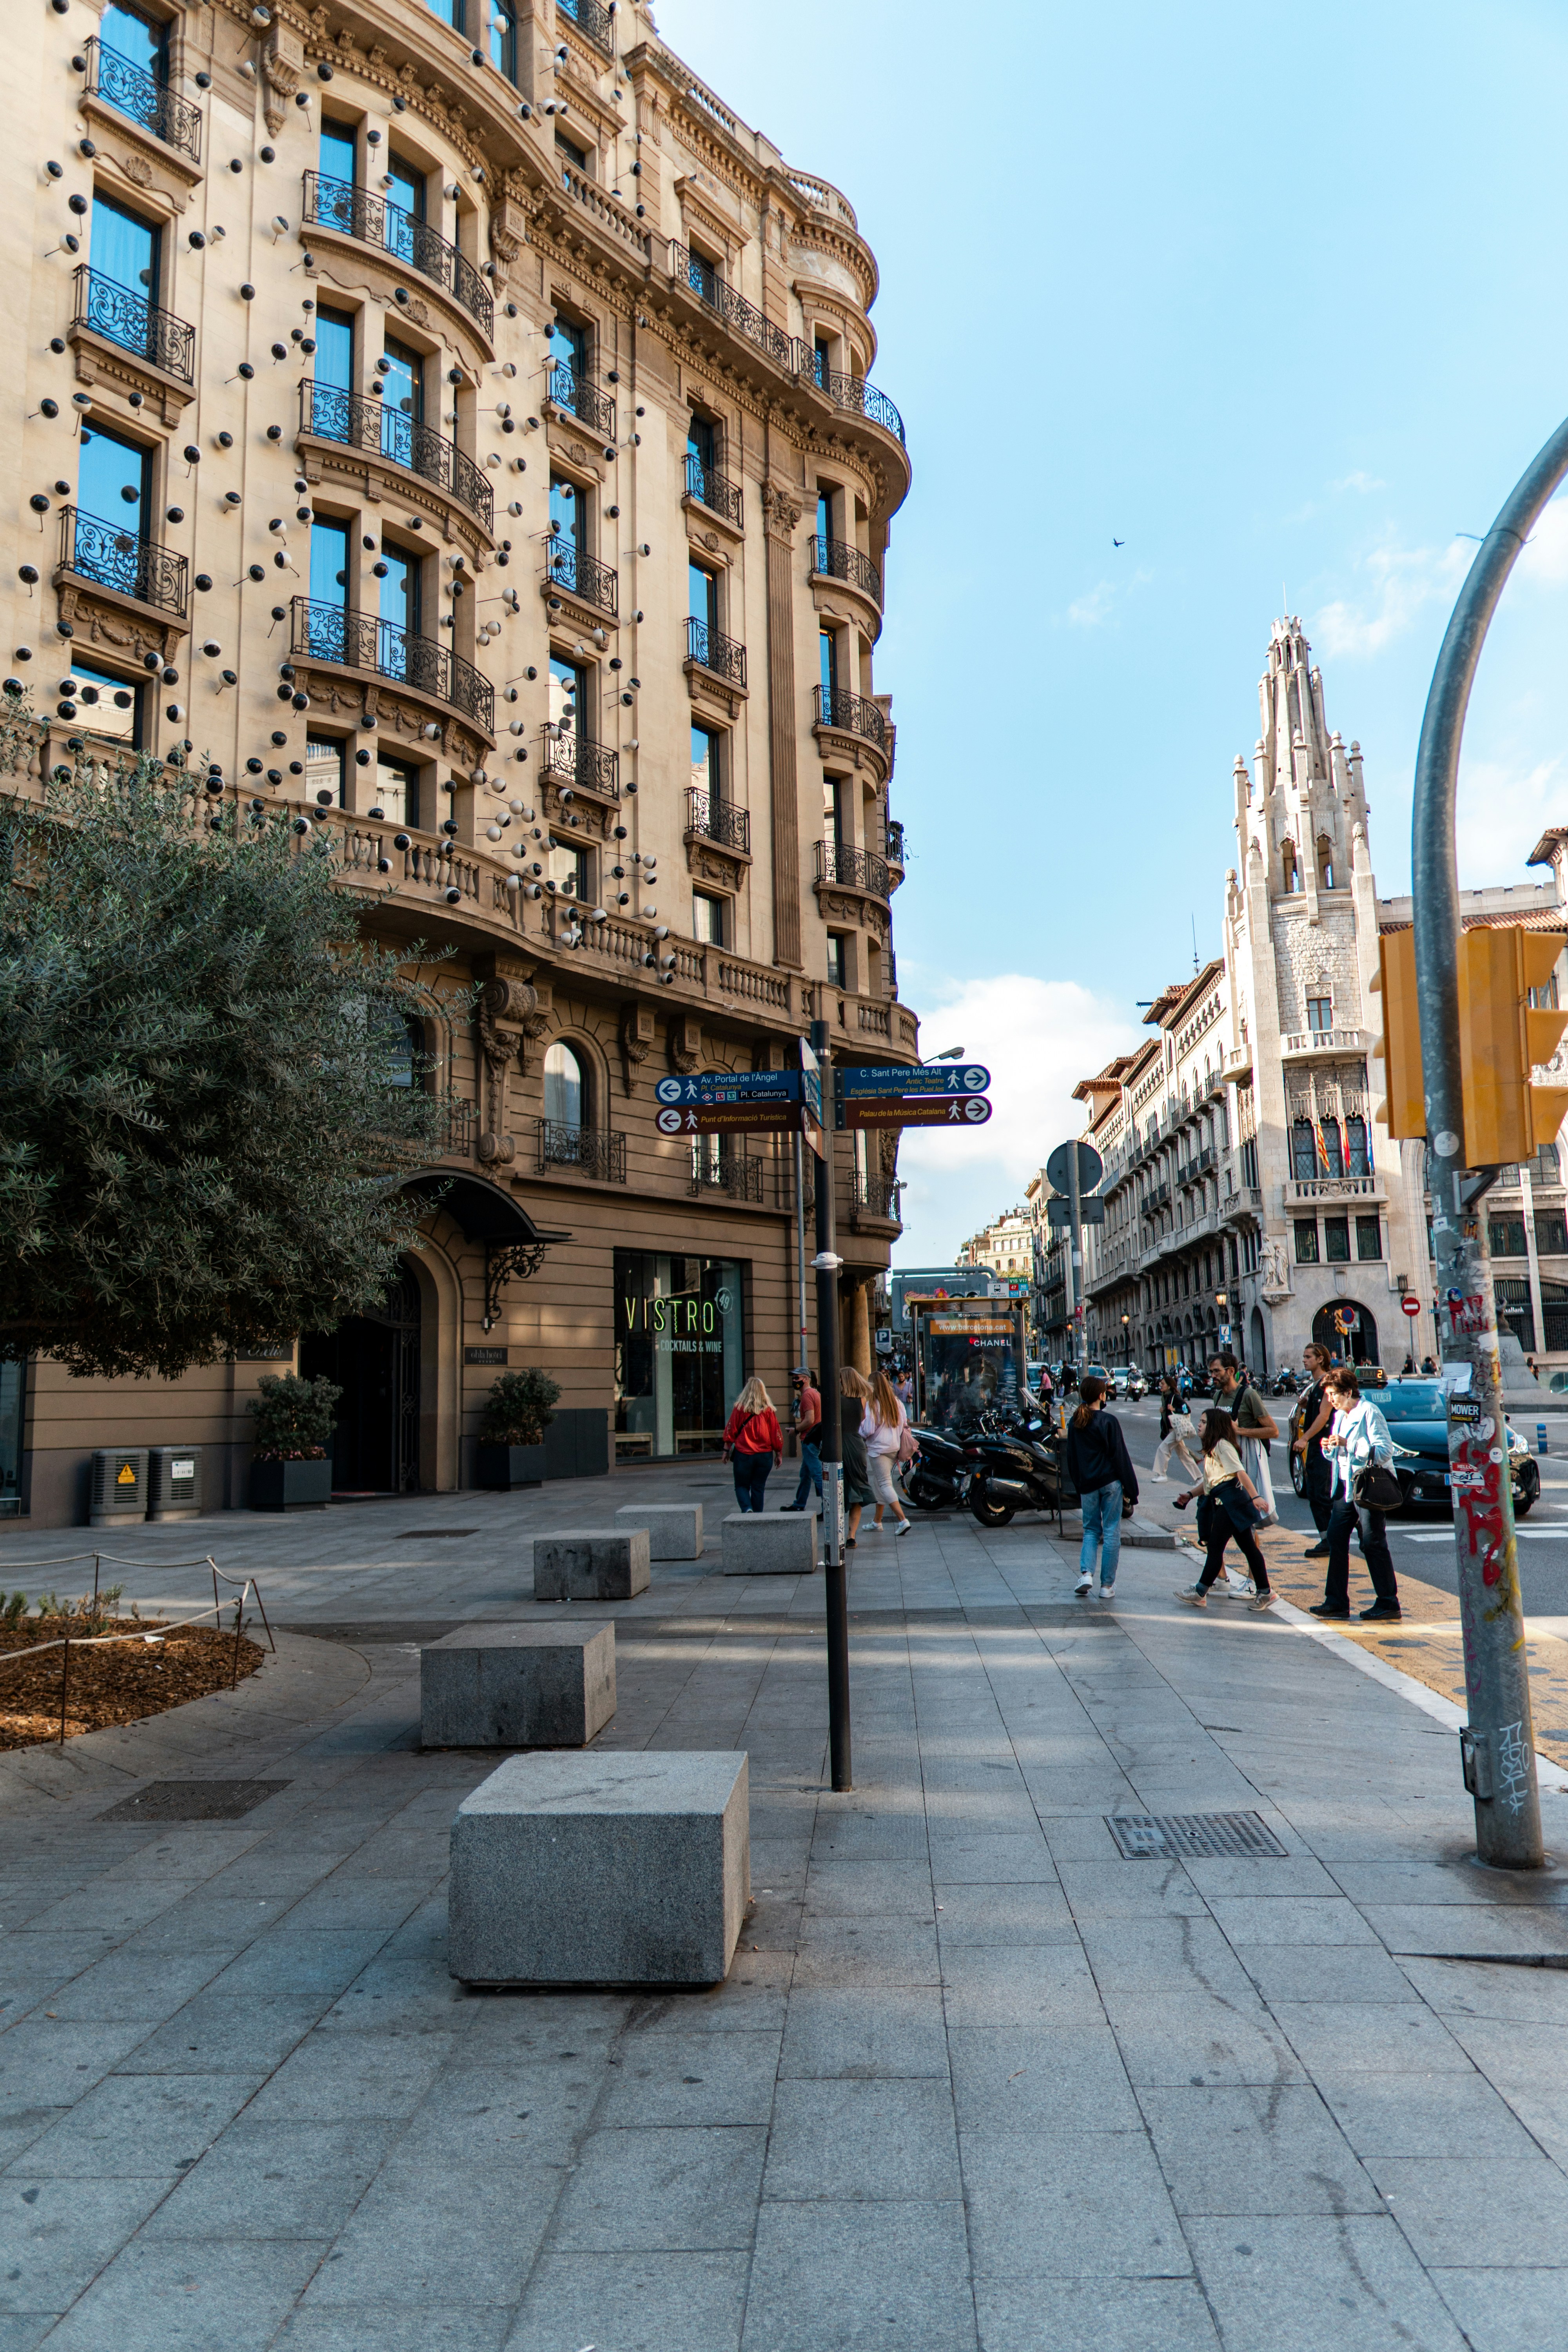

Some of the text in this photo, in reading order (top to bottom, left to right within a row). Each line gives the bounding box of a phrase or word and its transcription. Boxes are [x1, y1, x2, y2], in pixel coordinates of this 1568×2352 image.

[715, 1075, 737, 1083] Portal
[752, 1072, 777, 1082] l'Àngel
[625, 1294, 730, 1333] VISTRO 49
[879, 1332, 887, 1341] P
[661, 1340, 722, 1352] COCKTAILS & WINE
[471, 1350, 502, 1359] ohla hotel
[1377, 1370, 1383, 1379] 2
[1451, 1404, 1479, 1416] MOWER
